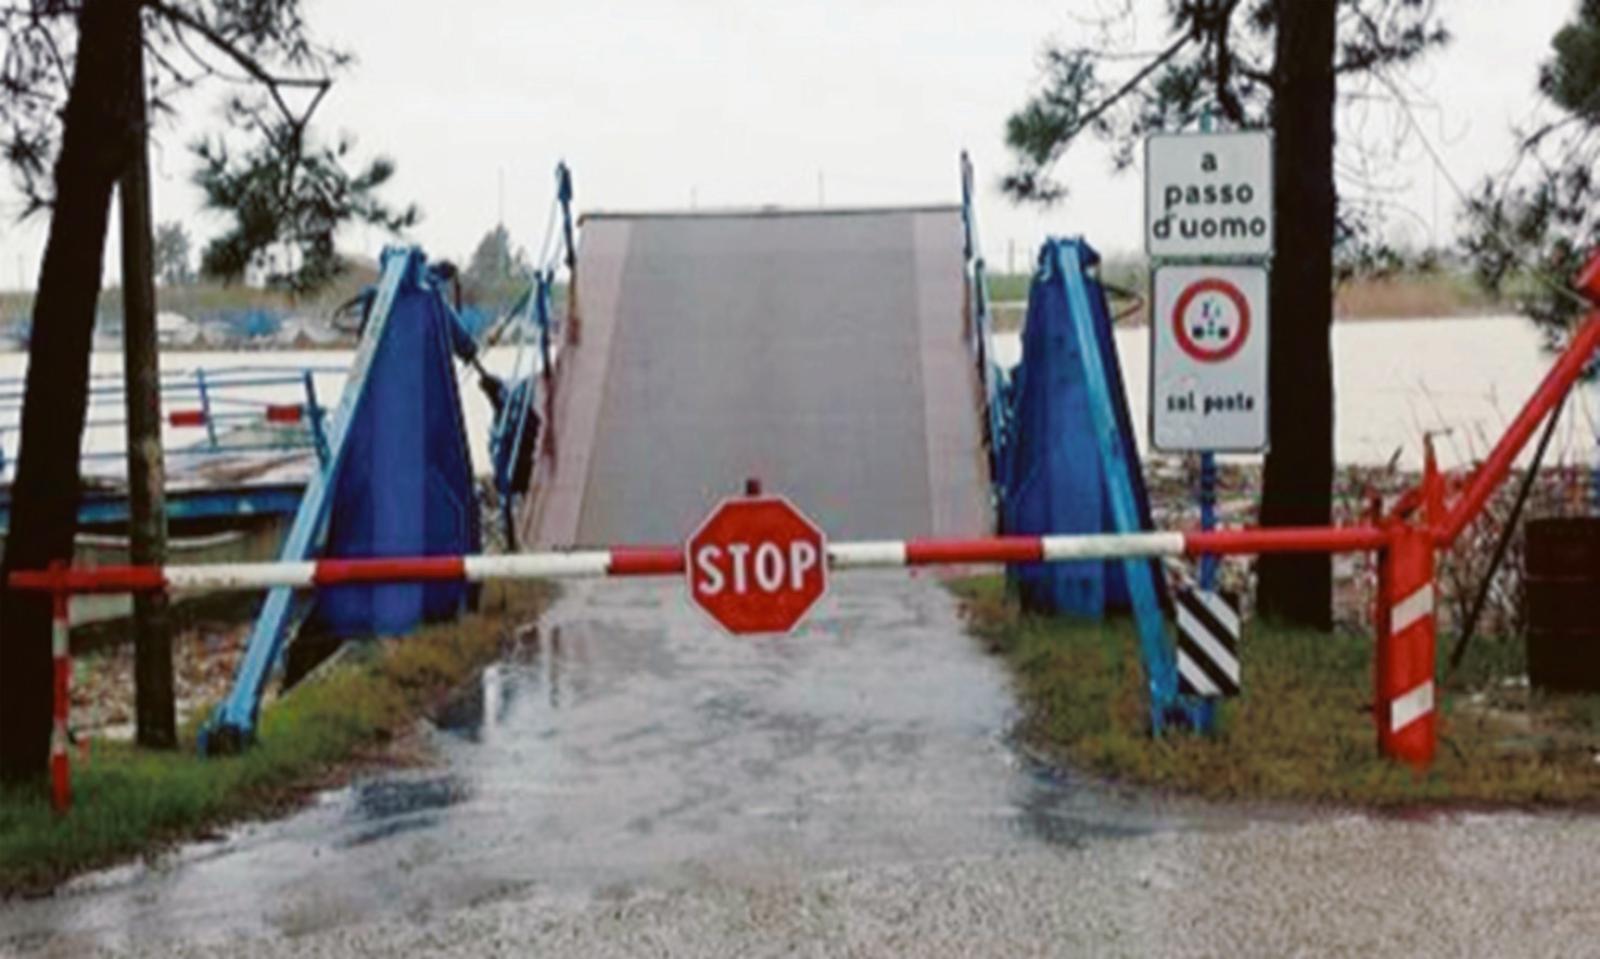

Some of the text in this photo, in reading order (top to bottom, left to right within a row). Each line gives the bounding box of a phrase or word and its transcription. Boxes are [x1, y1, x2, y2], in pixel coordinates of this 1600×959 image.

[1201, 152, 1217, 172] a
[1164, 182, 1254, 210] passo
[1153, 213, 1266, 239] d'uomo
[697, 541, 817, 595] STOP
